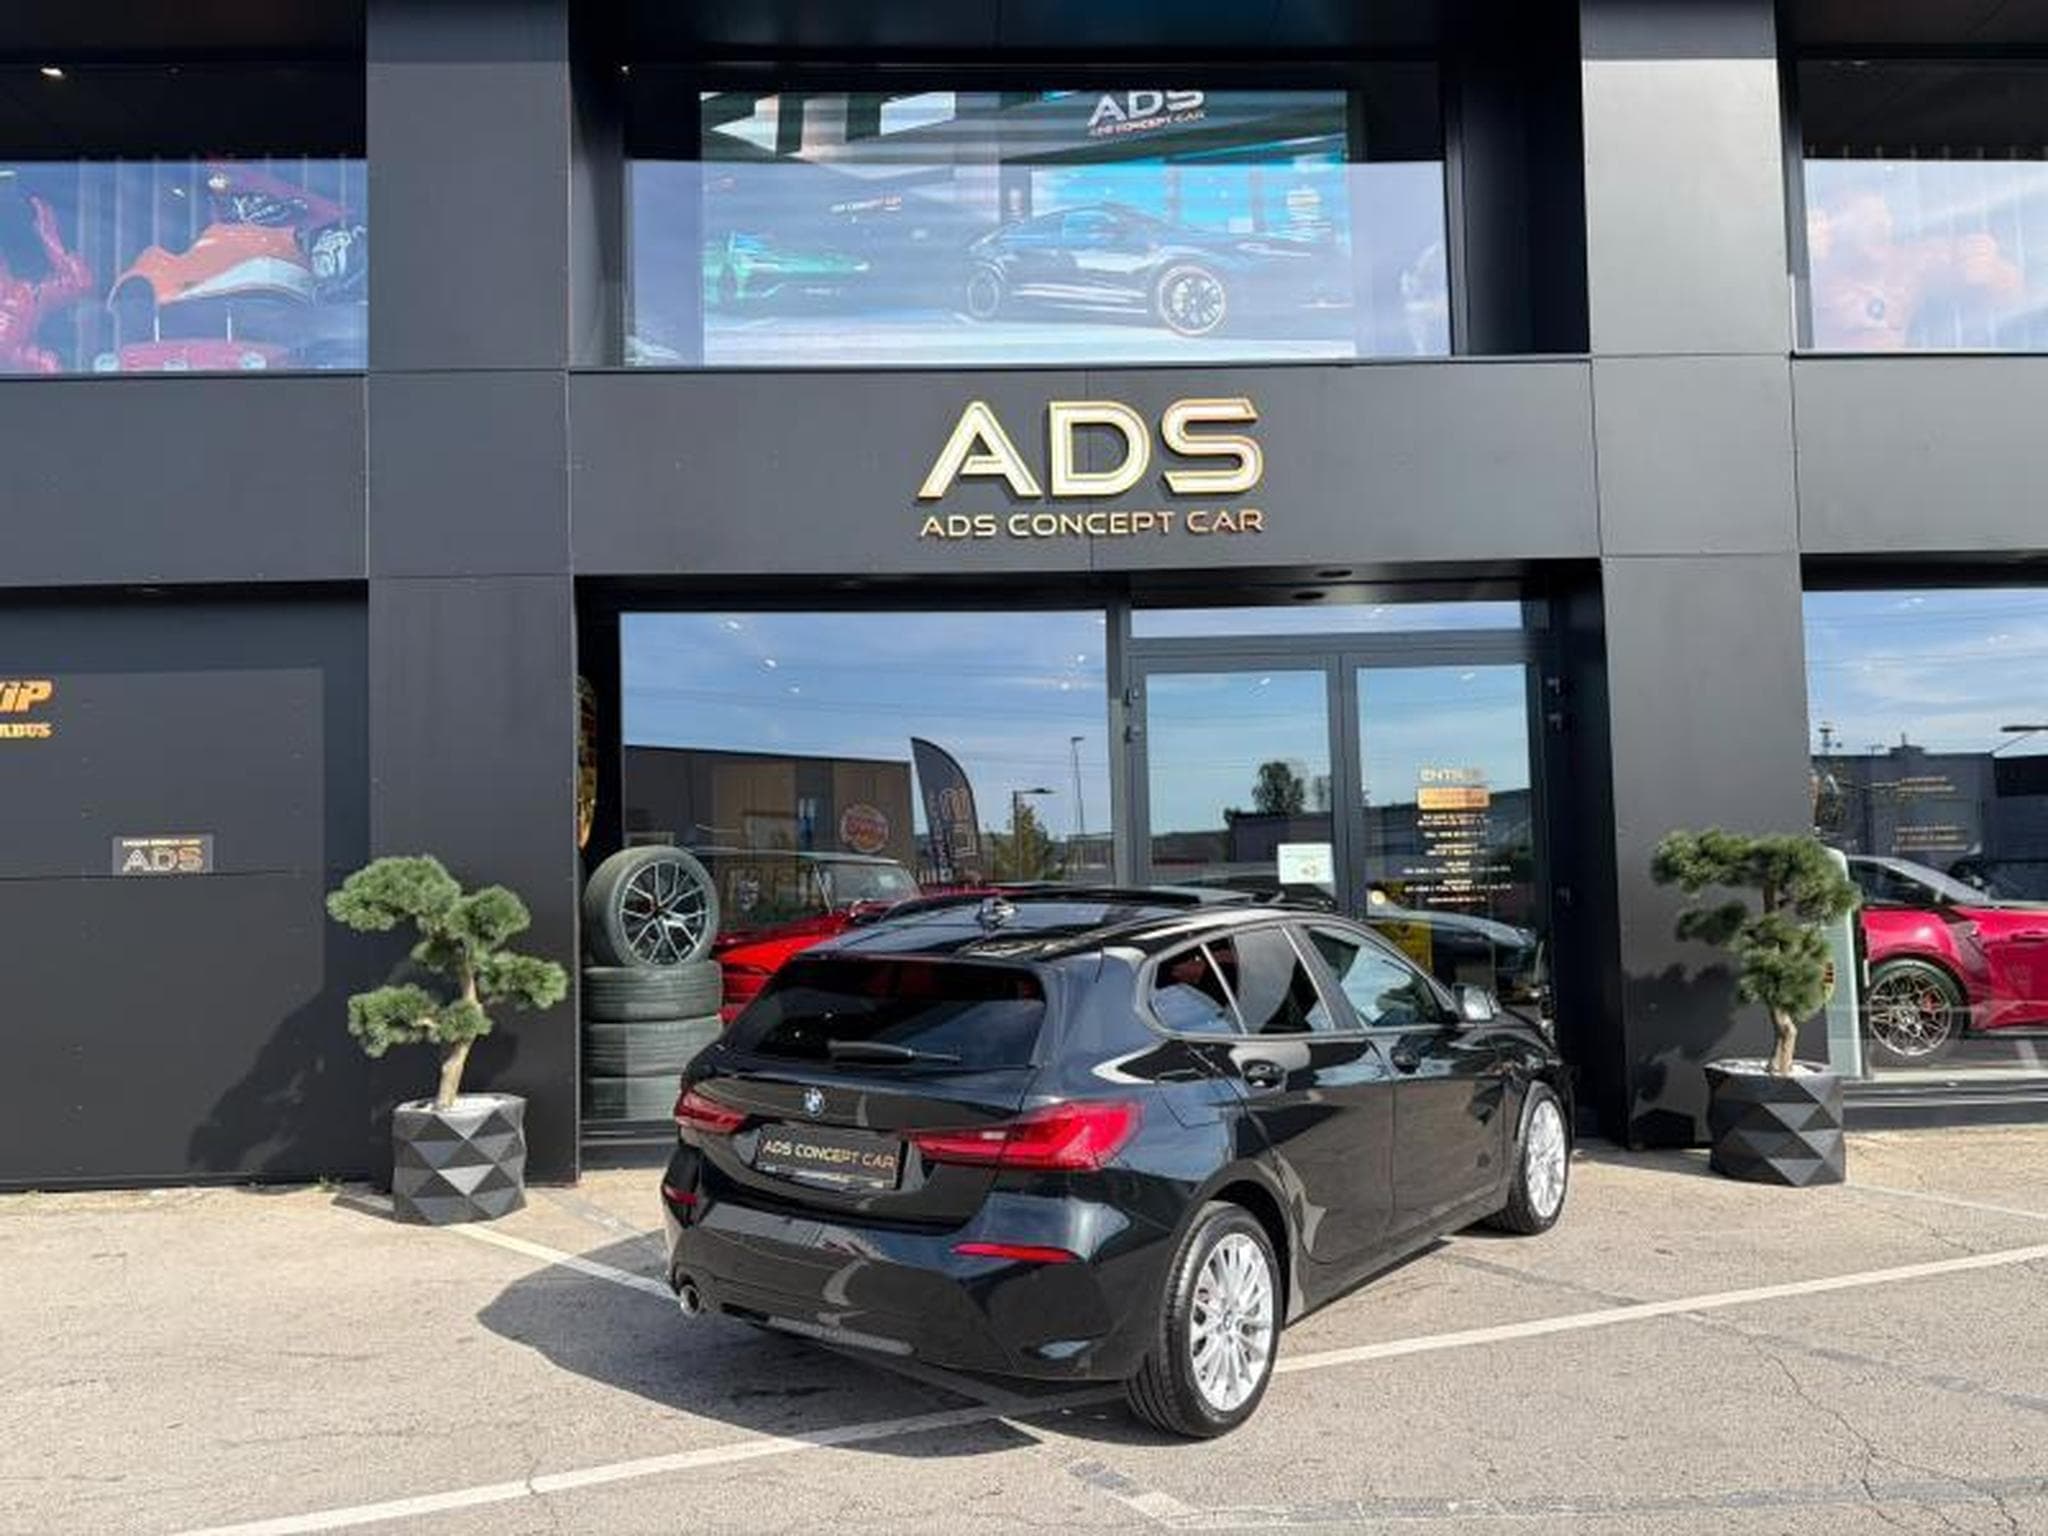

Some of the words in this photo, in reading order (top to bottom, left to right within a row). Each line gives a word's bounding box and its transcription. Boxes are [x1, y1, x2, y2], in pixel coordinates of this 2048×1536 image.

[917, 397, 1264, 499] ADS
[919, 514, 998, 539] ADS
[1008, 511, 1175, 537] CONCEPT
[1186, 509, 1265, 533] CAR
[121, 847, 204, 873] ADS
[762, 1139, 792, 1156] ADS
[795, 1143, 859, 1164] CONCEPT
[862, 1153, 896, 1168] CAR
